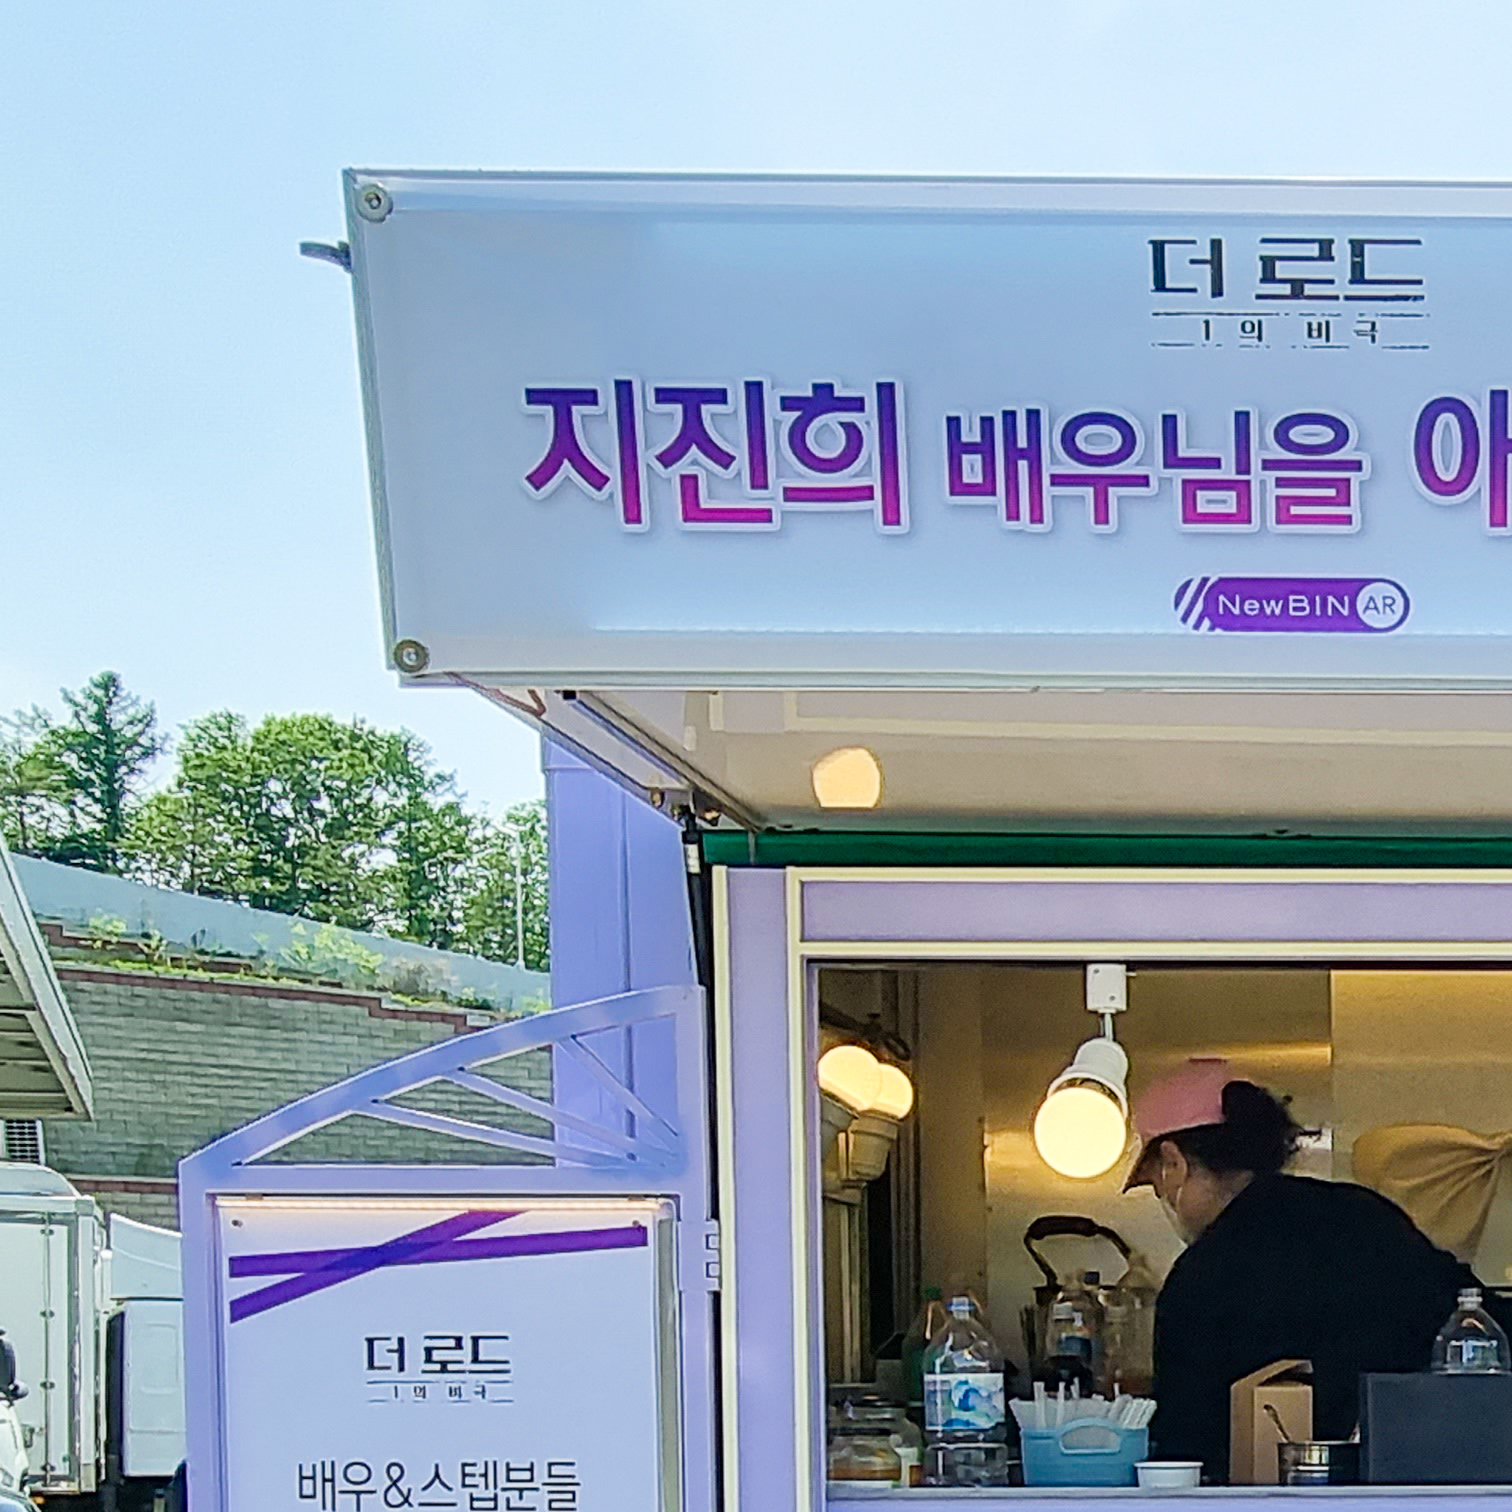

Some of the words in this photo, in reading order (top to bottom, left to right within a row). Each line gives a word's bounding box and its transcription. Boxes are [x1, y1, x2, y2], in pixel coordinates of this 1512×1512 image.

[1147, 236, 1225, 299] 더
[1253, 236, 1426, 302] 로드
[522, 377, 902, 529] 지진희
[944, 407, 1365, 528] 배우님을
[1217, 593, 1350, 617] NewBIN
[1362, 594, 1398, 616] AR
[364, 1336, 406, 1373] 더
[420, 1335, 512, 1375] 로드
[298, 1460, 582, 1512] 배우&스텝분들
